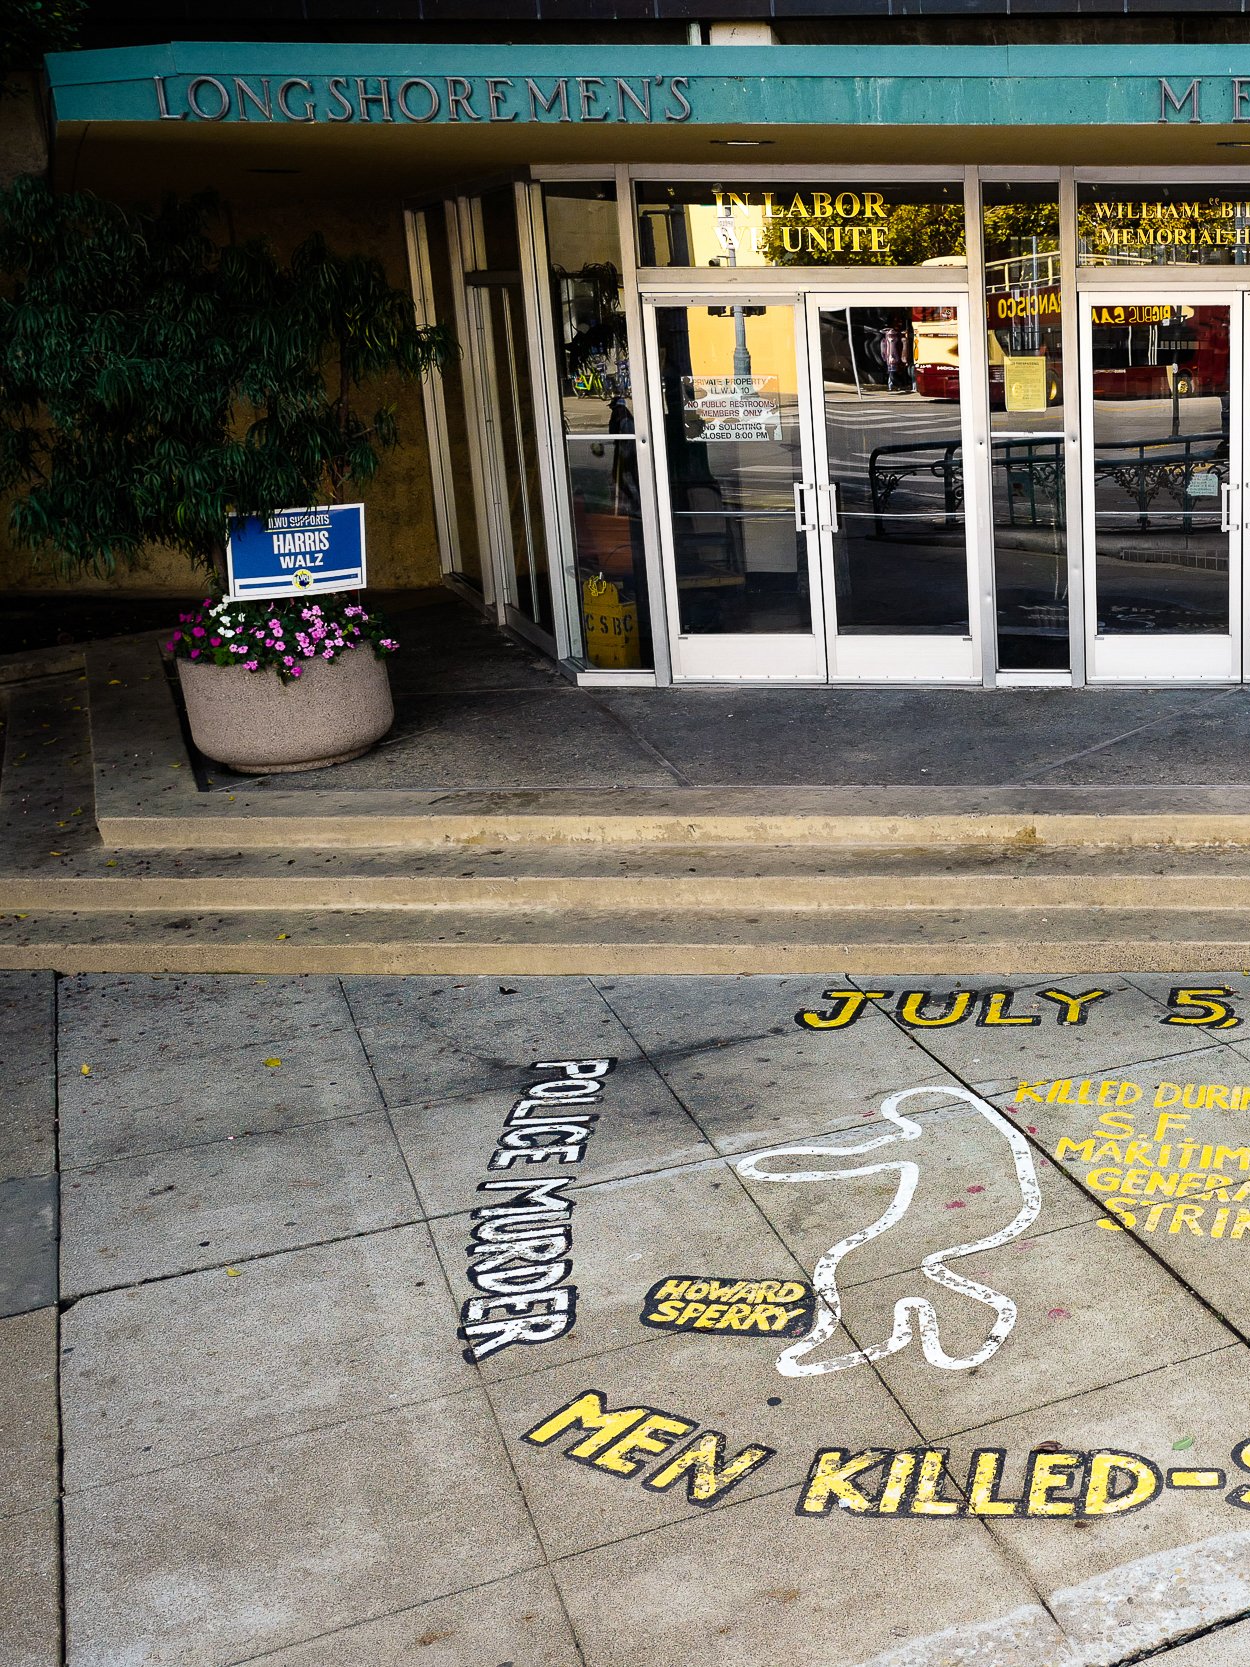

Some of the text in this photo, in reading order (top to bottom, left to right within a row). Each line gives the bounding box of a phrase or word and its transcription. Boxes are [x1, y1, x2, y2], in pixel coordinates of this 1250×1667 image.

[152, 75, 692, 124] LONGSHOREMEN'S
[711, 192, 886, 218] IN LABOR
[1094, 200, 1200, 219] WILLIAM
[711, 226, 889, 253] WE UNITE
[1100, 228, 1225, 246] MEMORIAL
[694, 378, 765, 386] PRIVATE PROPERTY
[700, 409, 763, 417] MEMBERS ONLY
[730, 400, 775, 408] RESTROOMS
[700, 432, 732, 440] CLOSED
[703, 422, 762, 431] NO SOLICITING
[289, 514, 330, 527] SUPPORTS
[272, 531, 330, 554] HARRIS
[279, 553, 324, 569] WALZ
[795, 986, 1107, 1031] JULY
[1014, 1079, 1143, 1106] KILLED
[456, 1057, 619, 1365] POLICE MURDER
[653, 1279, 806, 1303] HOWARD
[647, 1301, 806, 1331] SPERRY
[520, 1388, 776, 1508] MEN
